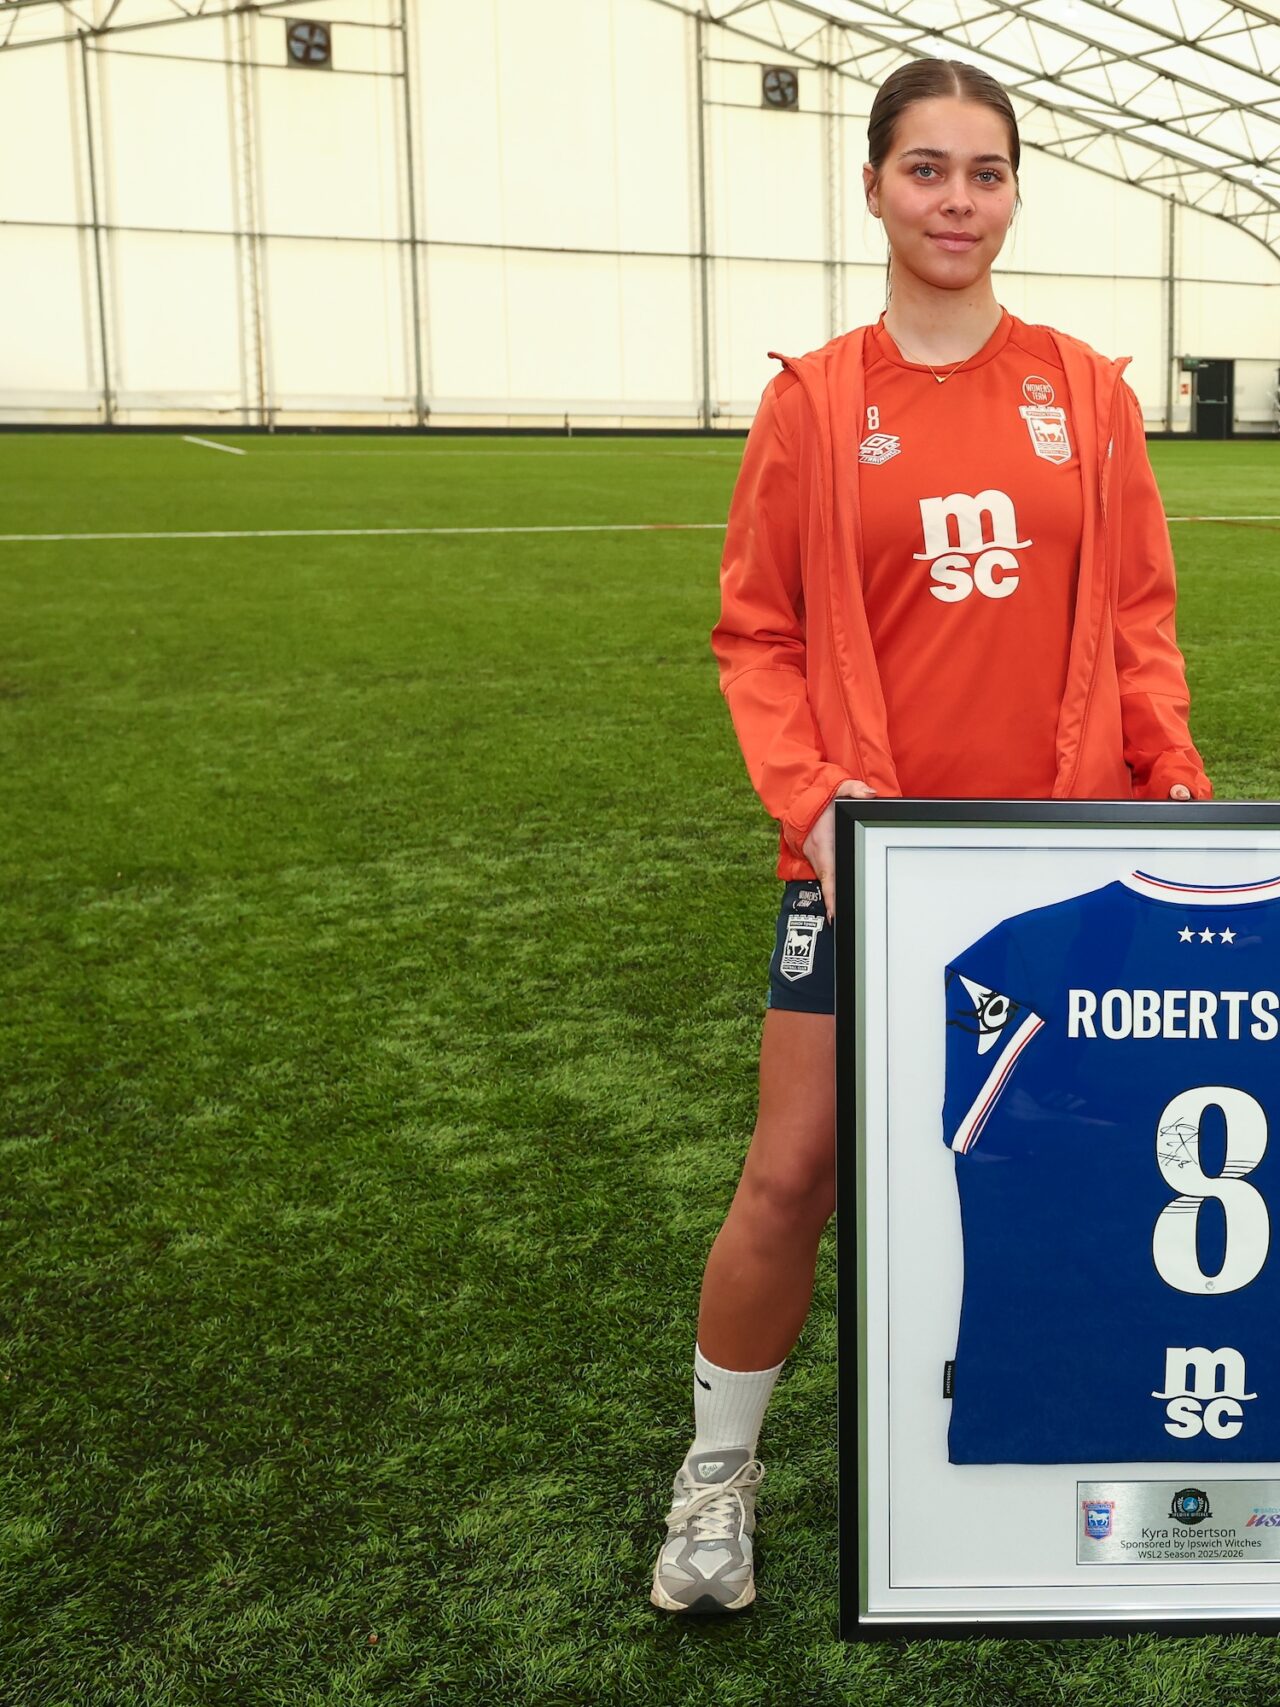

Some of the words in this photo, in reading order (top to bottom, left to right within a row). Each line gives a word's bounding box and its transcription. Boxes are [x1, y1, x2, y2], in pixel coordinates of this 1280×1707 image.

[866, 405, 880, 430] 8
[1151, 1084, 1271, 1296] 8
[1141, 1527, 1168, 1541] Kyra
[1172, 1526, 1236, 1538] Robertson
[1120, 1539, 1171, 1549] Sponsored
[1173, 1539, 1184, 1549] by
[1187, 1538, 1222, 1549] Ipswich
[1224, 1538, 1262, 1548] Witches
[1138, 1550, 1162, 1558] WSL2
[1164, 1549, 1195, 1558] Season
[1197, 1549, 1244, 1558] 2025/2026
